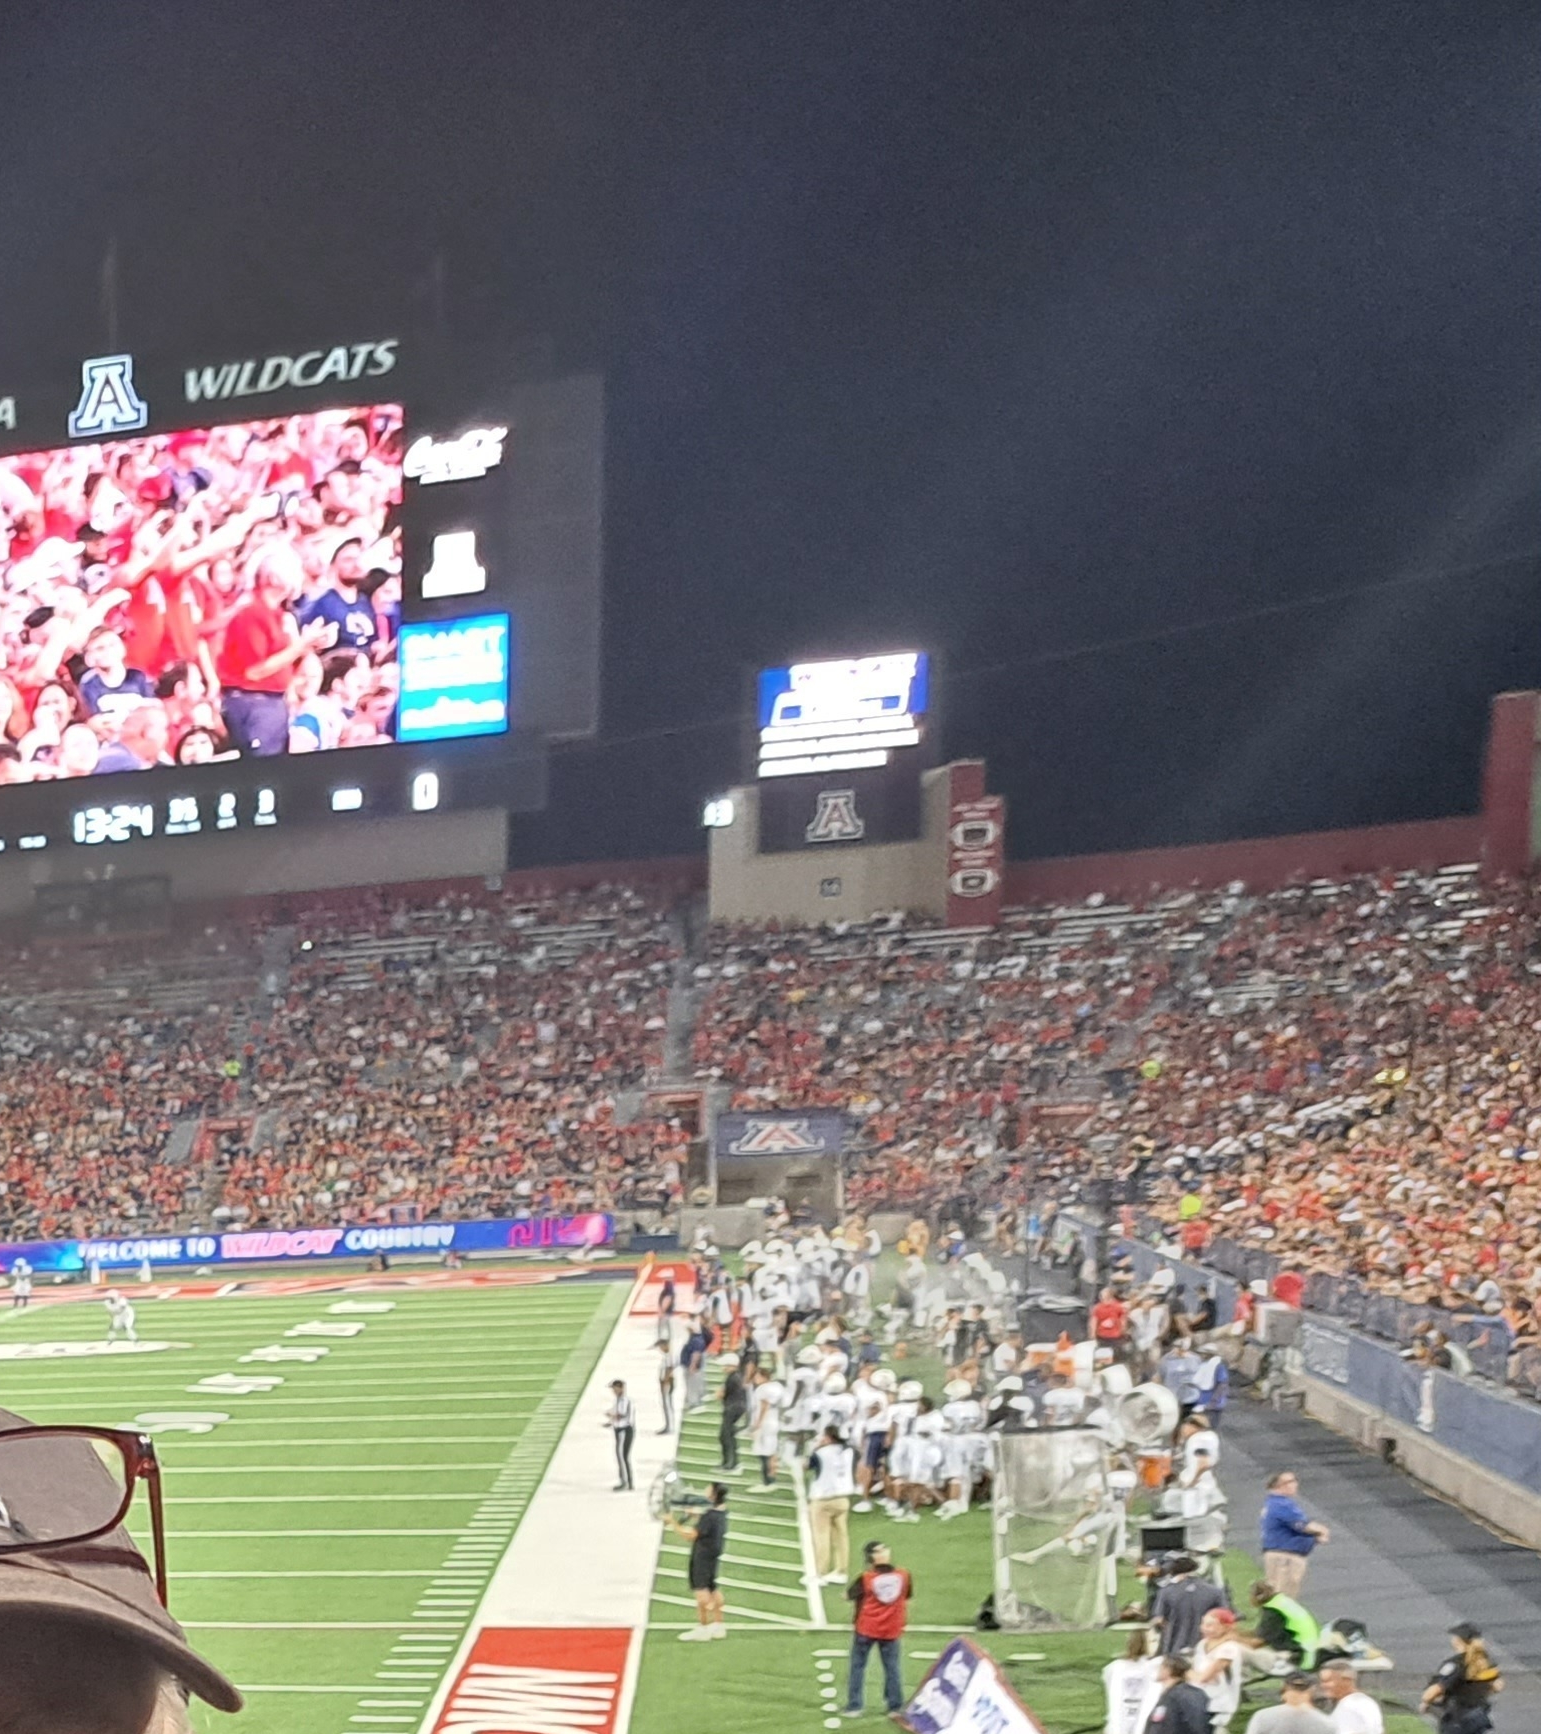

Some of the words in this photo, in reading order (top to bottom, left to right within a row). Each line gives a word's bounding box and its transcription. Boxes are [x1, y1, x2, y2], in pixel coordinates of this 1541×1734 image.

[68, 354, 148, 438] A
[183, 340, 399, 402] WILDCATS
[804, 789, 865, 842] A
[186, 1235, 216, 1258] TO
[344, 1223, 456, 1251] COUNTRY
